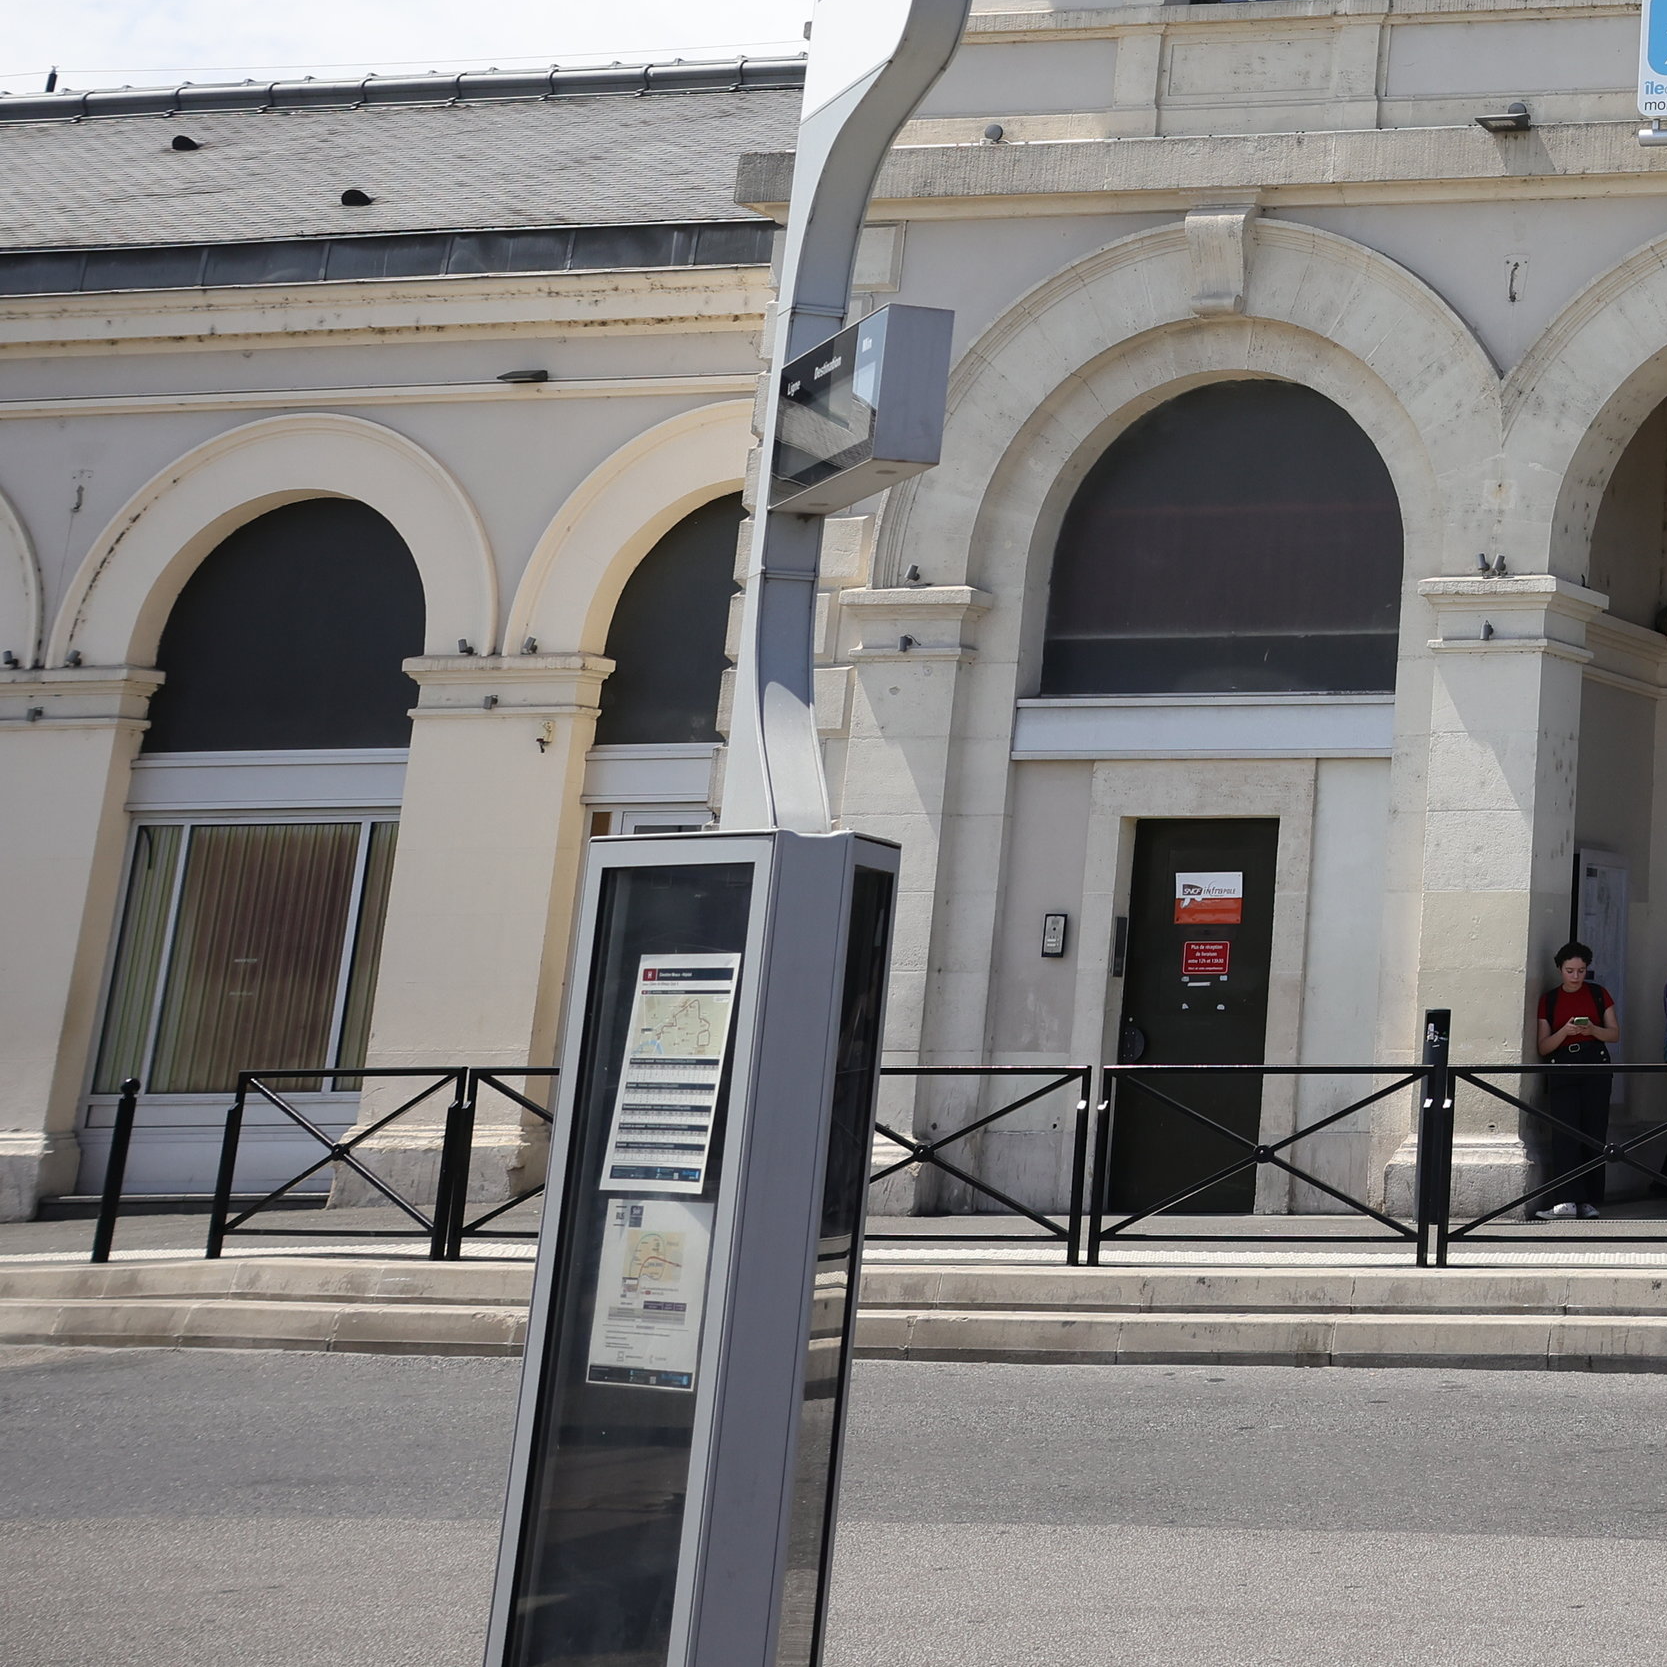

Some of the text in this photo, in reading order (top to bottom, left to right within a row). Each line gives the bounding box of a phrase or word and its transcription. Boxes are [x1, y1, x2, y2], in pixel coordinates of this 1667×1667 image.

[787, 380, 801, 396] Ligne
[814, 356, 842, 380] Destination
[1183, 887, 1202, 895] SNCF
